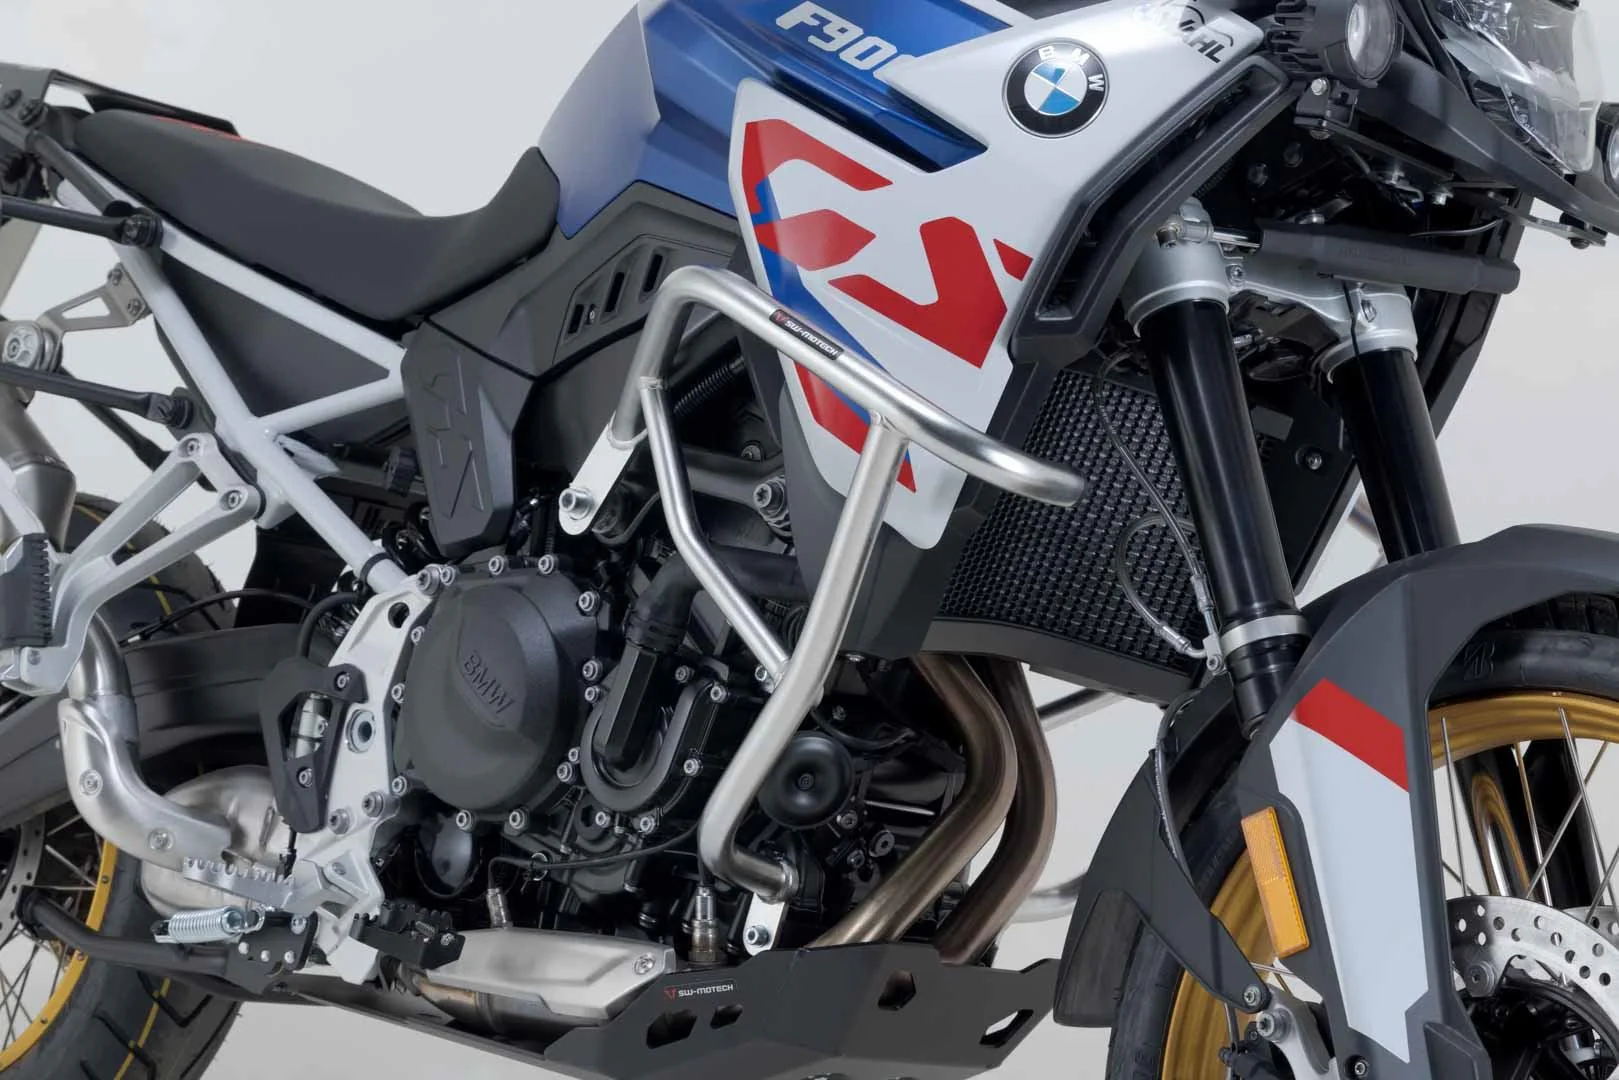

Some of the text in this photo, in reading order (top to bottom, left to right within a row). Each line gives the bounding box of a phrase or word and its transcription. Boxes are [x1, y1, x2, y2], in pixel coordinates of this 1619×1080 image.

[1038, 45, 1105, 92] BMW
[784, 320, 839, 356] SW-MOTECH
[463, 654, 516, 714] BMW
[678, 983, 734, 998] SW-MOTECH
